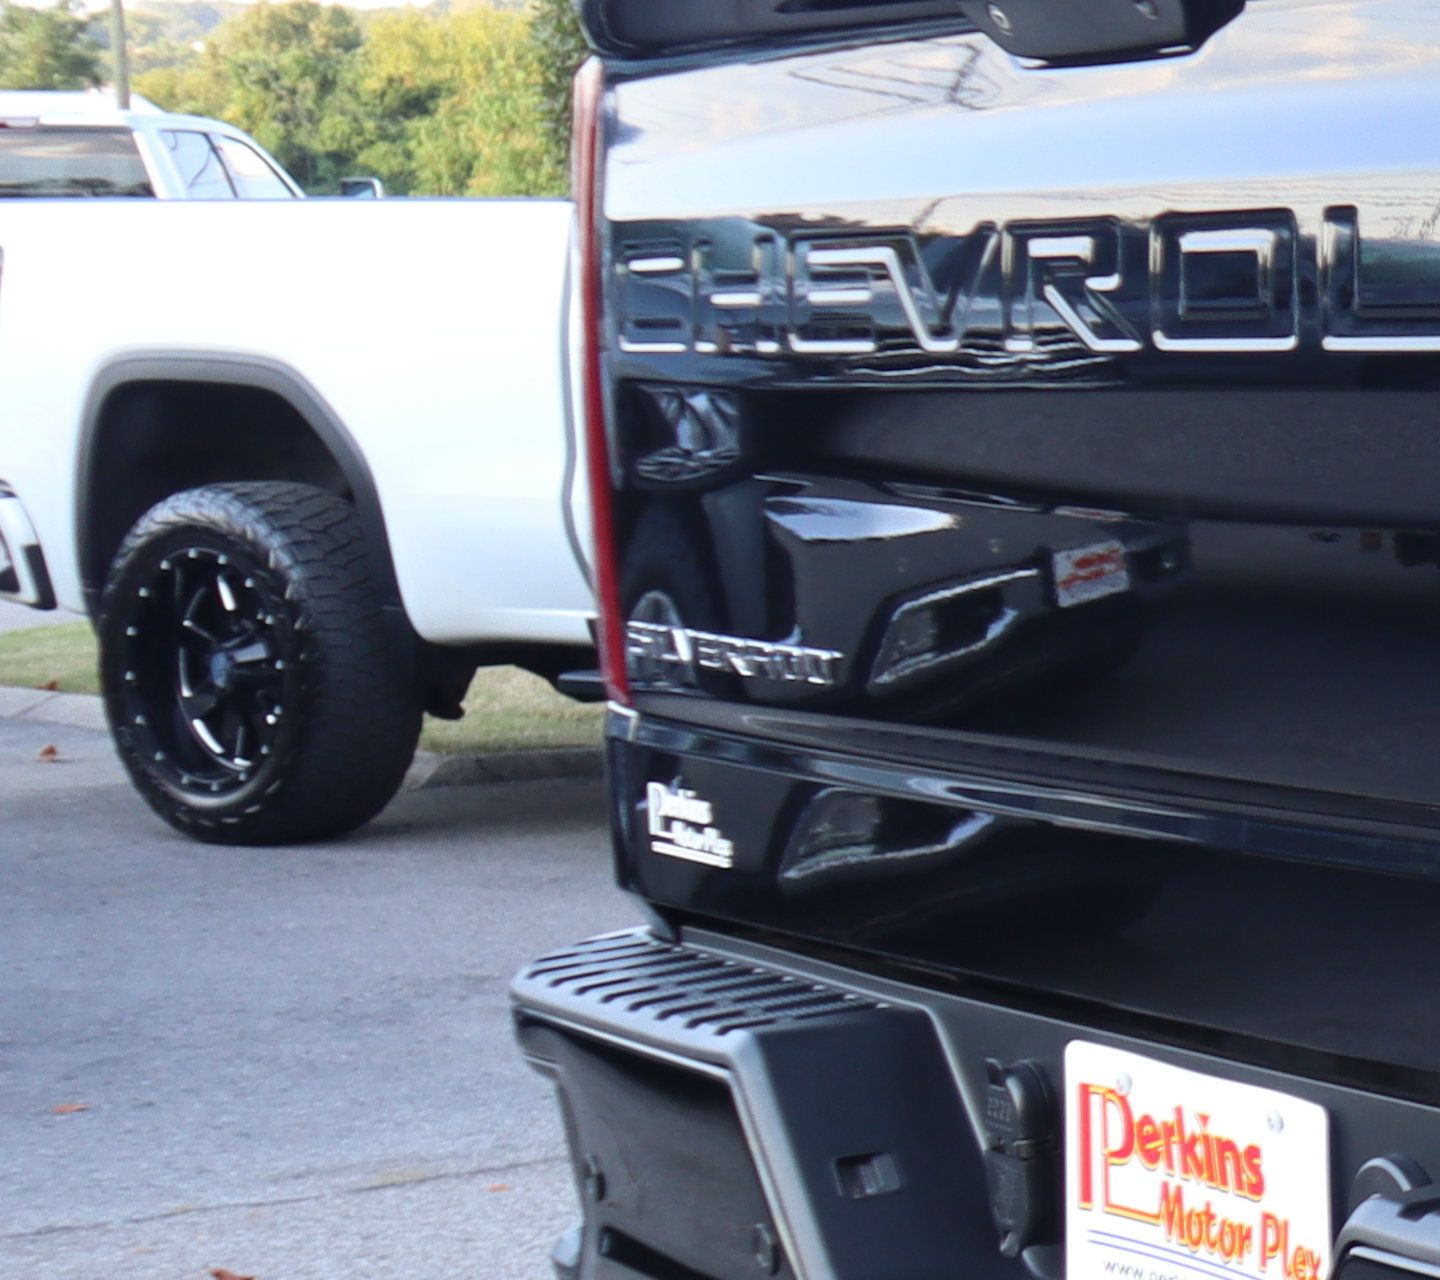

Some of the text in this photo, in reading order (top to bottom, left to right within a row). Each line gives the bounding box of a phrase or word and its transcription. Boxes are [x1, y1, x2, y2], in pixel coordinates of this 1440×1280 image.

[626, 620, 845, 686] SILVERADO
[1077, 1081, 1265, 1210] Perkins
[1160, 1180, 1253, 1265] Motor
